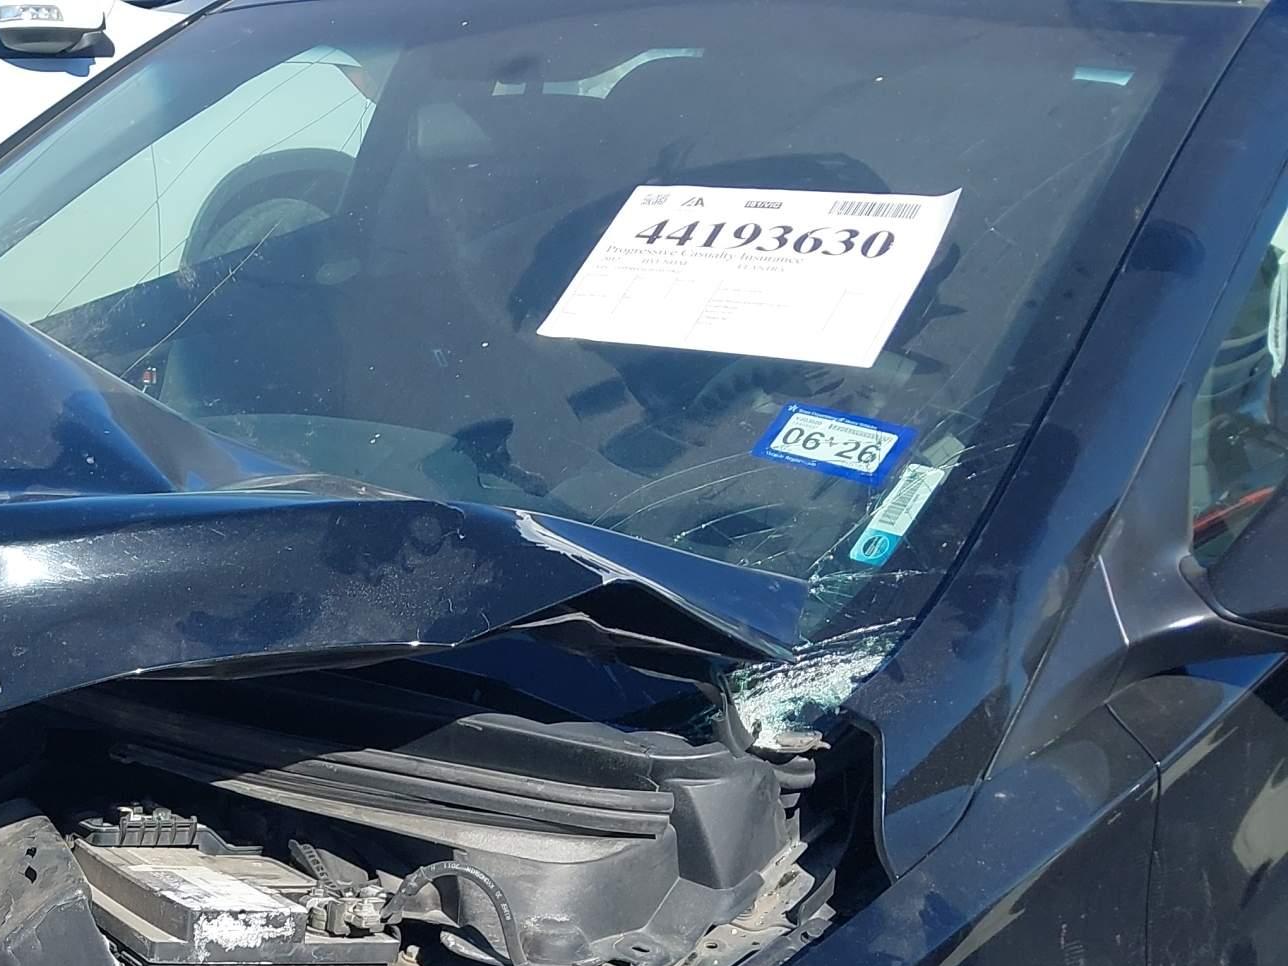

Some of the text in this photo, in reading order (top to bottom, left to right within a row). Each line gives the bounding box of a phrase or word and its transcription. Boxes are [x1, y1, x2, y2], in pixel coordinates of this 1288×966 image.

[635, 218, 895, 259] 44193630
[606, 245, 804, 265] Progressive Casualty Insurance
[782, 427, 825, 450] 06
